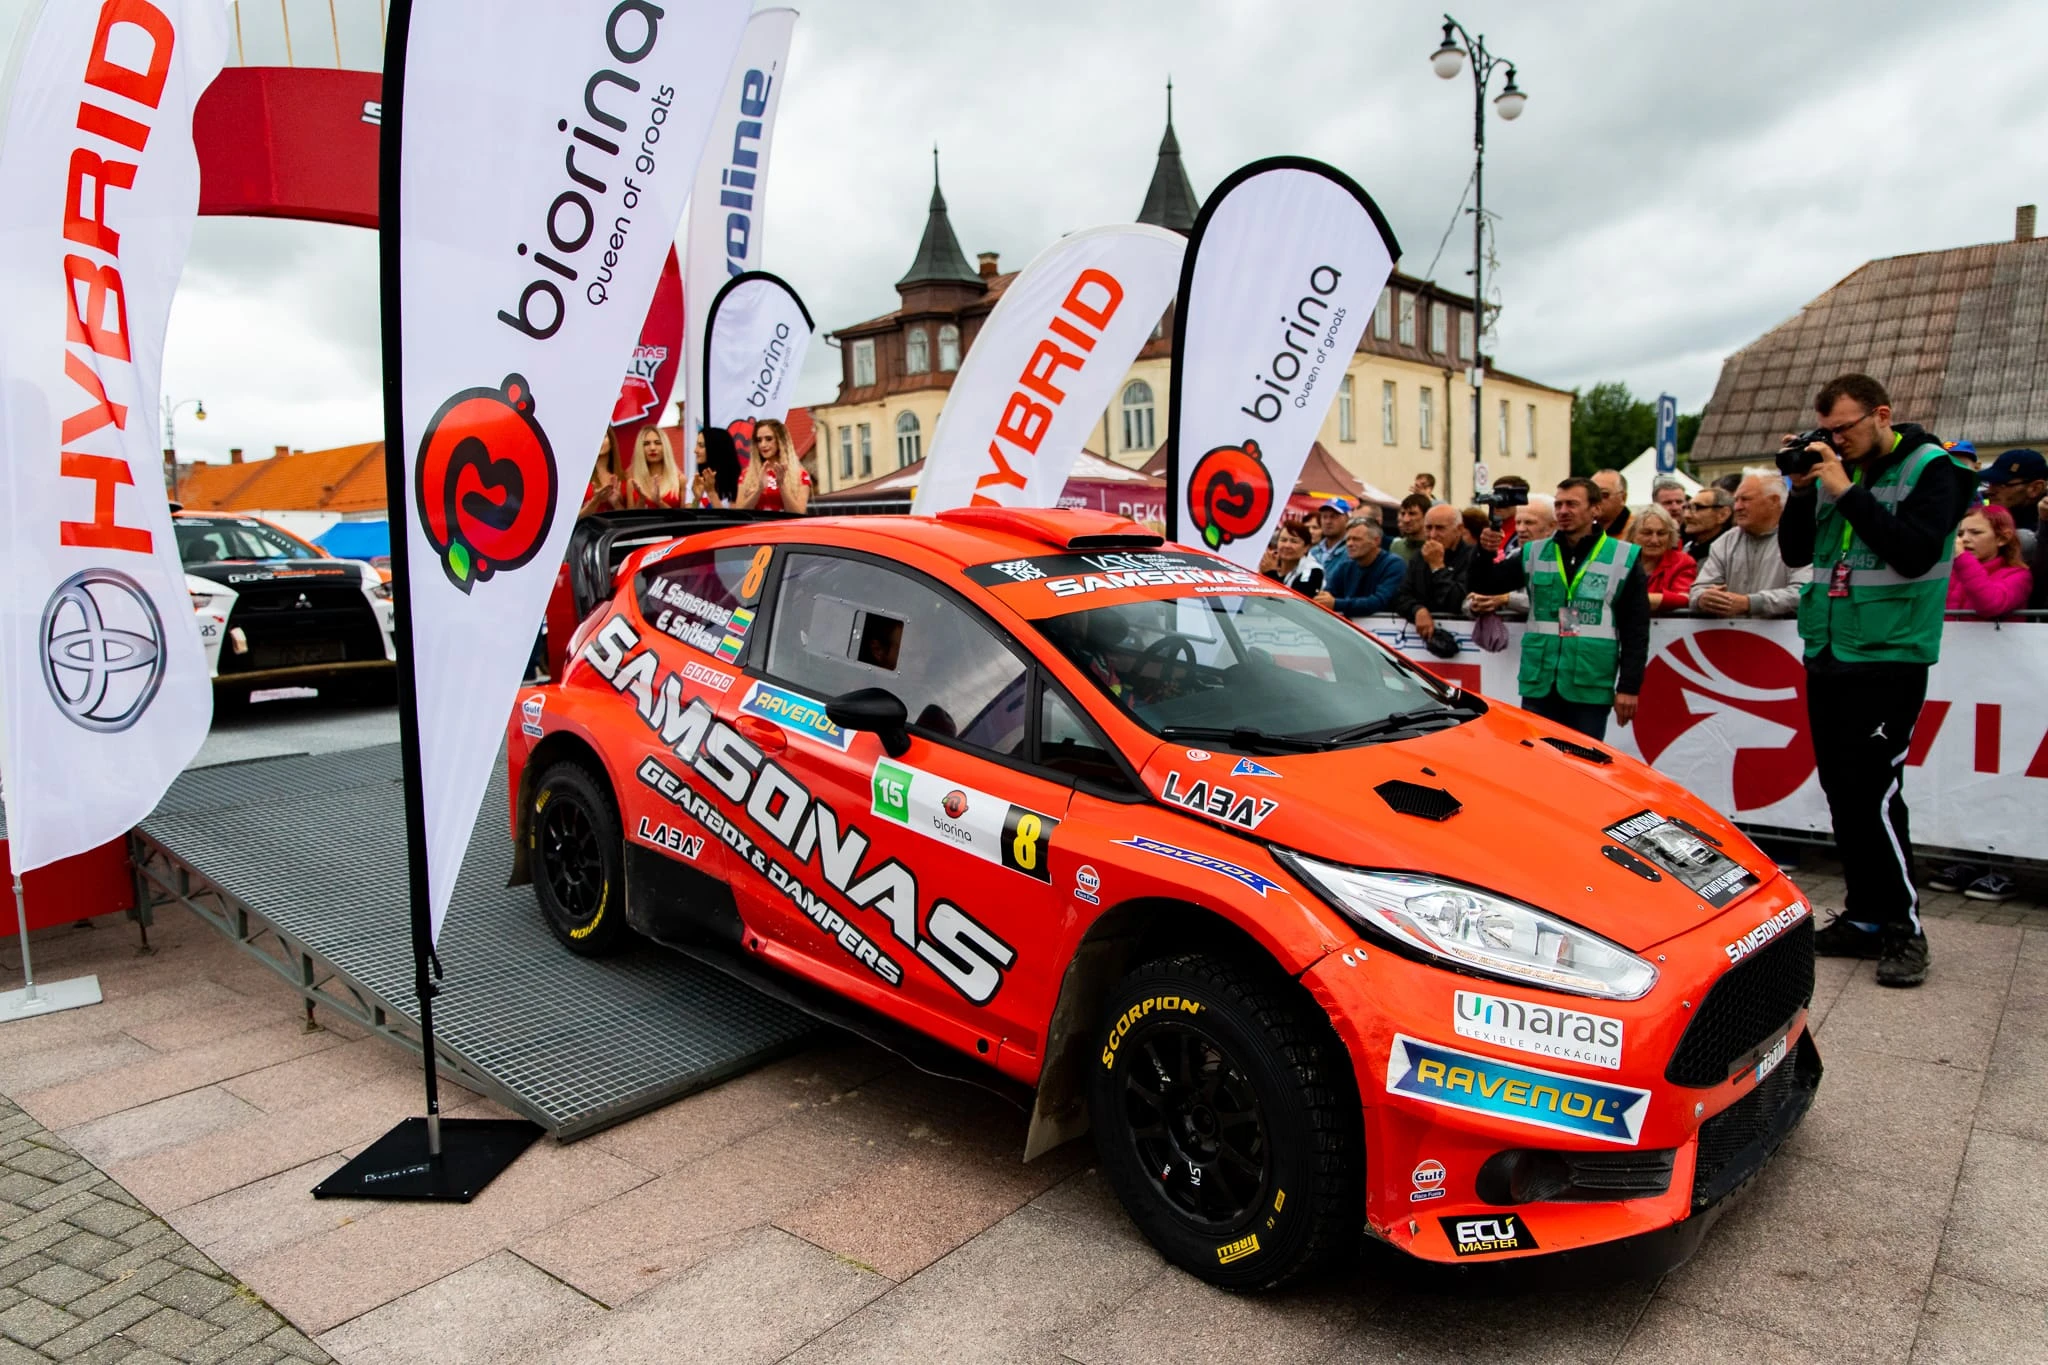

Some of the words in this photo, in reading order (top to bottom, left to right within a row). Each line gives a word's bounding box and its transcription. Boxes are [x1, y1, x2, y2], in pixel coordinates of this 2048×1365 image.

[497, 0, 665, 340] biorina
[587, 216, 631, 306] Queen
[623, 176, 642, 209] of
[635, 85, 675, 175] groats
[60, 0, 175, 554] HYBRID
[746, 322, 789, 408] biorina
[1240, 265, 1342, 423] biorina
[1294, 365, 1320, 408] Queen
[1317, 348, 1328, 364] of
[1324, 307, 1346, 349] groats
[1662, 400, 1674, 441] P
[741, 545, 773, 599] 8
[1045, 570, 1259, 597] SAMSONAS
[663, 583, 732, 627] Samsonas
[667, 615, 721, 653] Snitkas
[583, 615, 1014, 1001] SAMSONAS
[878, 778, 904, 808] 15
[933, 815, 972, 842] biorina
[1013, 813, 1042, 870] 8
[638, 757, 752, 860] GEARBOX
[751, 852, 766, 873] &
[767, 862, 900, 986] DAMPERS
[1078, 872, 1098, 888] Gulf
[1139, 841, 1257, 884] RAVENOL
[1102, 996, 1200, 1070] SCORPION
[1457, 1026, 1525, 1048] FLEXIBLE
[1534, 1042, 1618, 1067] PACKAGING
[1417, 1058, 1616, 1124] RAVENOL
[1415, 1171, 1444, 1182] Gulf
[1216, 1233, 1261, 1265] PIRELLI
[1456, 1216, 1515, 1243] ECU
[1458, 1238, 1518, 1253] MASTER
